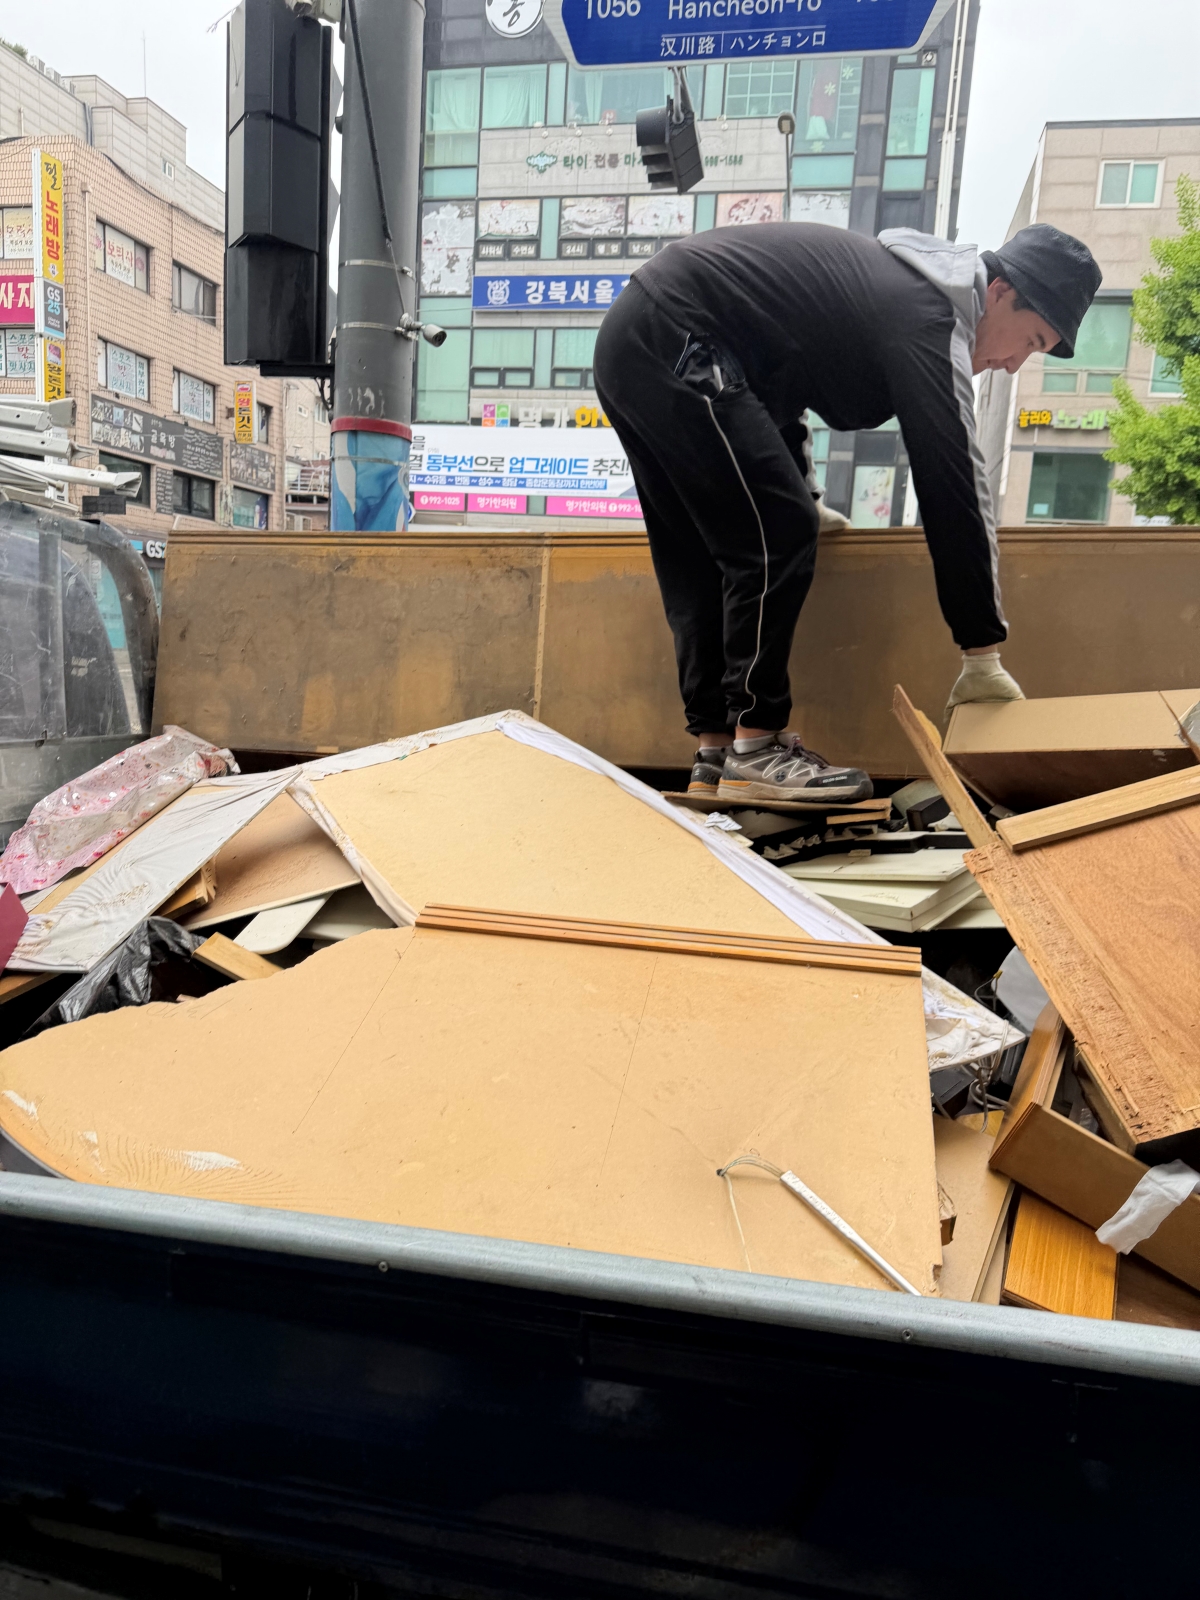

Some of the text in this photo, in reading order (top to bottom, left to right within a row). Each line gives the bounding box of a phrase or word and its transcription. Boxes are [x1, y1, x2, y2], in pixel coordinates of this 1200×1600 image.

[587, 0, 641, 19] 1056
[660, 36, 716, 57] 汉川路
[730, 30, 827, 51] ハンチョンロ
[563, 154, 588, 169] 타이
[45, 190, 60, 260] 노래방
[47, 286, 60, 302] GS
[525, 279, 628, 304] 강북서울
[48, 298, 60, 316] 25
[426, 454, 505, 474] 동부선으로
[508, 456, 589, 476] 업그레이드
[592, 458, 631, 477] 추진!
[477, 497, 517, 510] 명가한의원
[566, 500, 607, 513] 명가한의원
